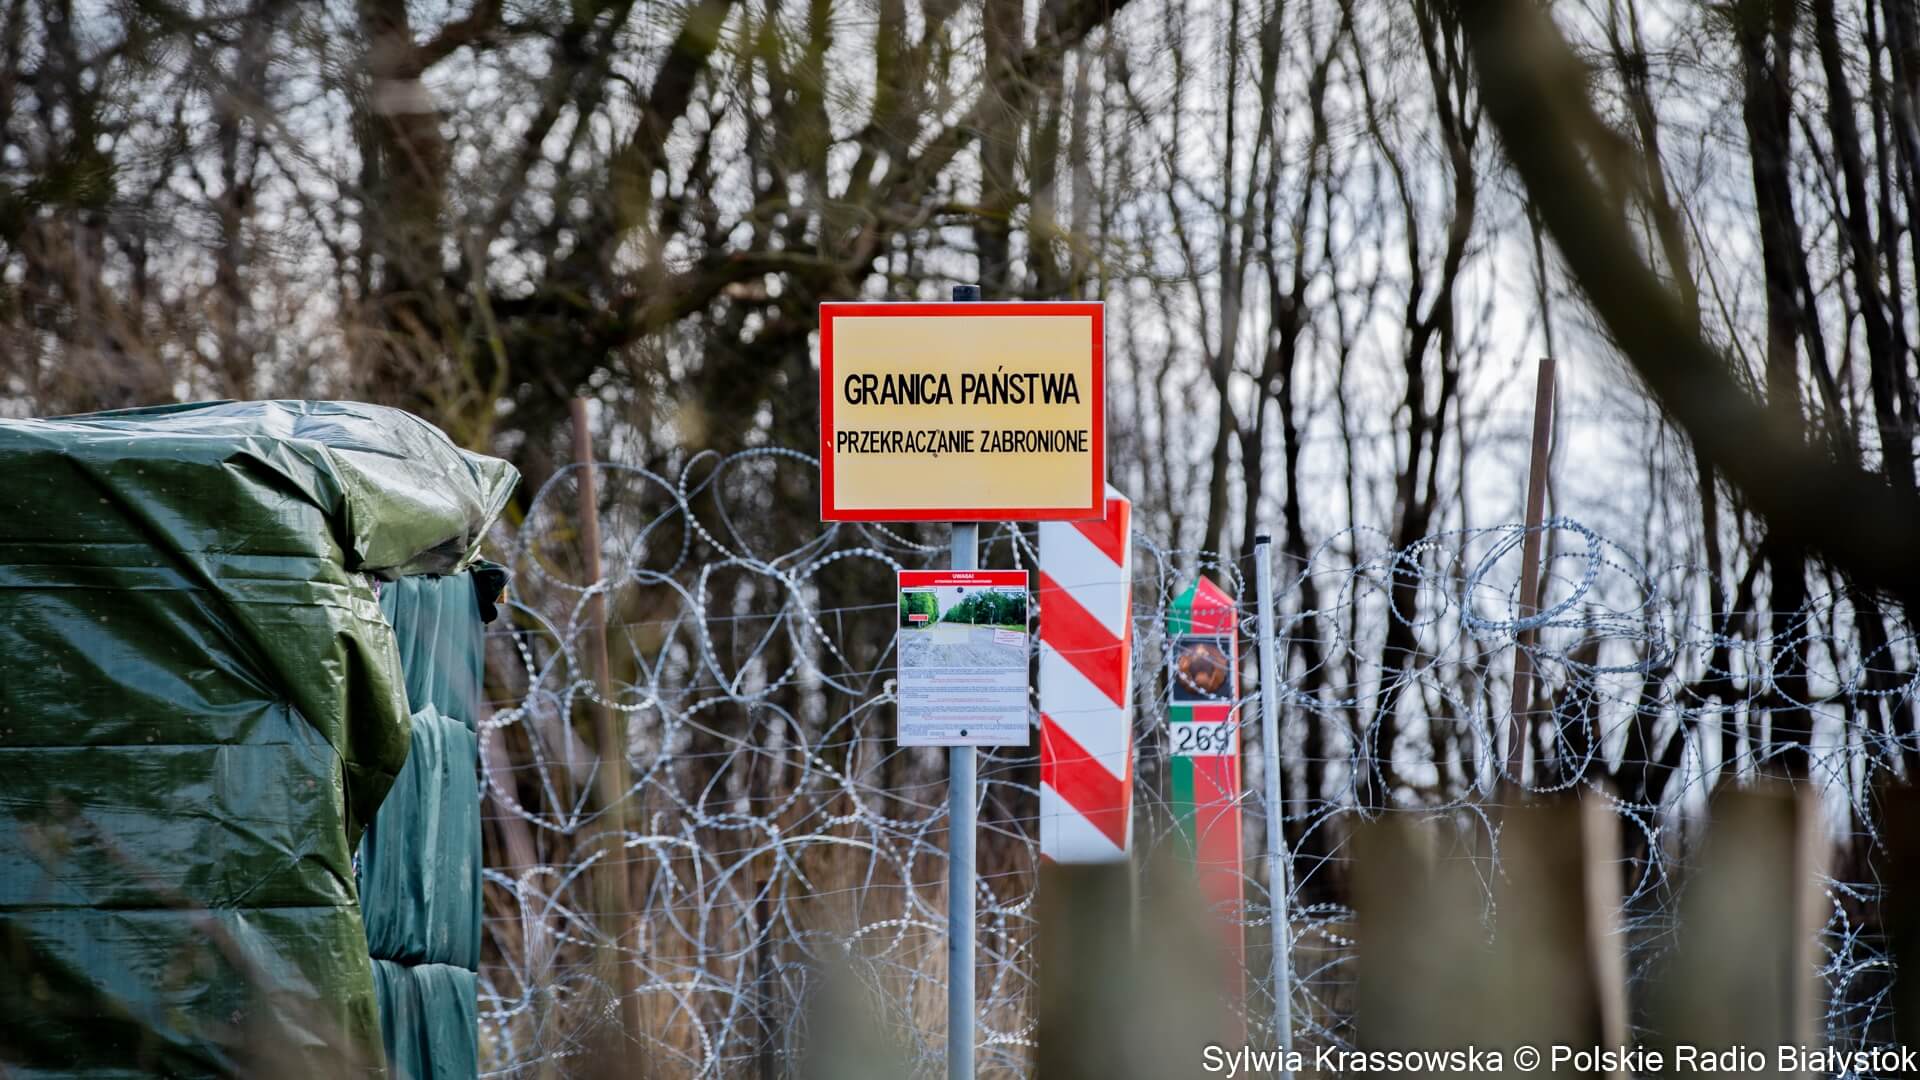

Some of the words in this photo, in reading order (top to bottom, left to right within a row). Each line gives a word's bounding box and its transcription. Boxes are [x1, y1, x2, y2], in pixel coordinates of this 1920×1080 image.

[844, 373, 953, 405] GRANICA
[961, 365, 1080, 405] PAŃSTWA
[836, 430, 975, 453] PRZEKRACZANIE
[981, 430, 1088, 453] ZABRONIONE
[1177, 725, 1230, 752] 269
